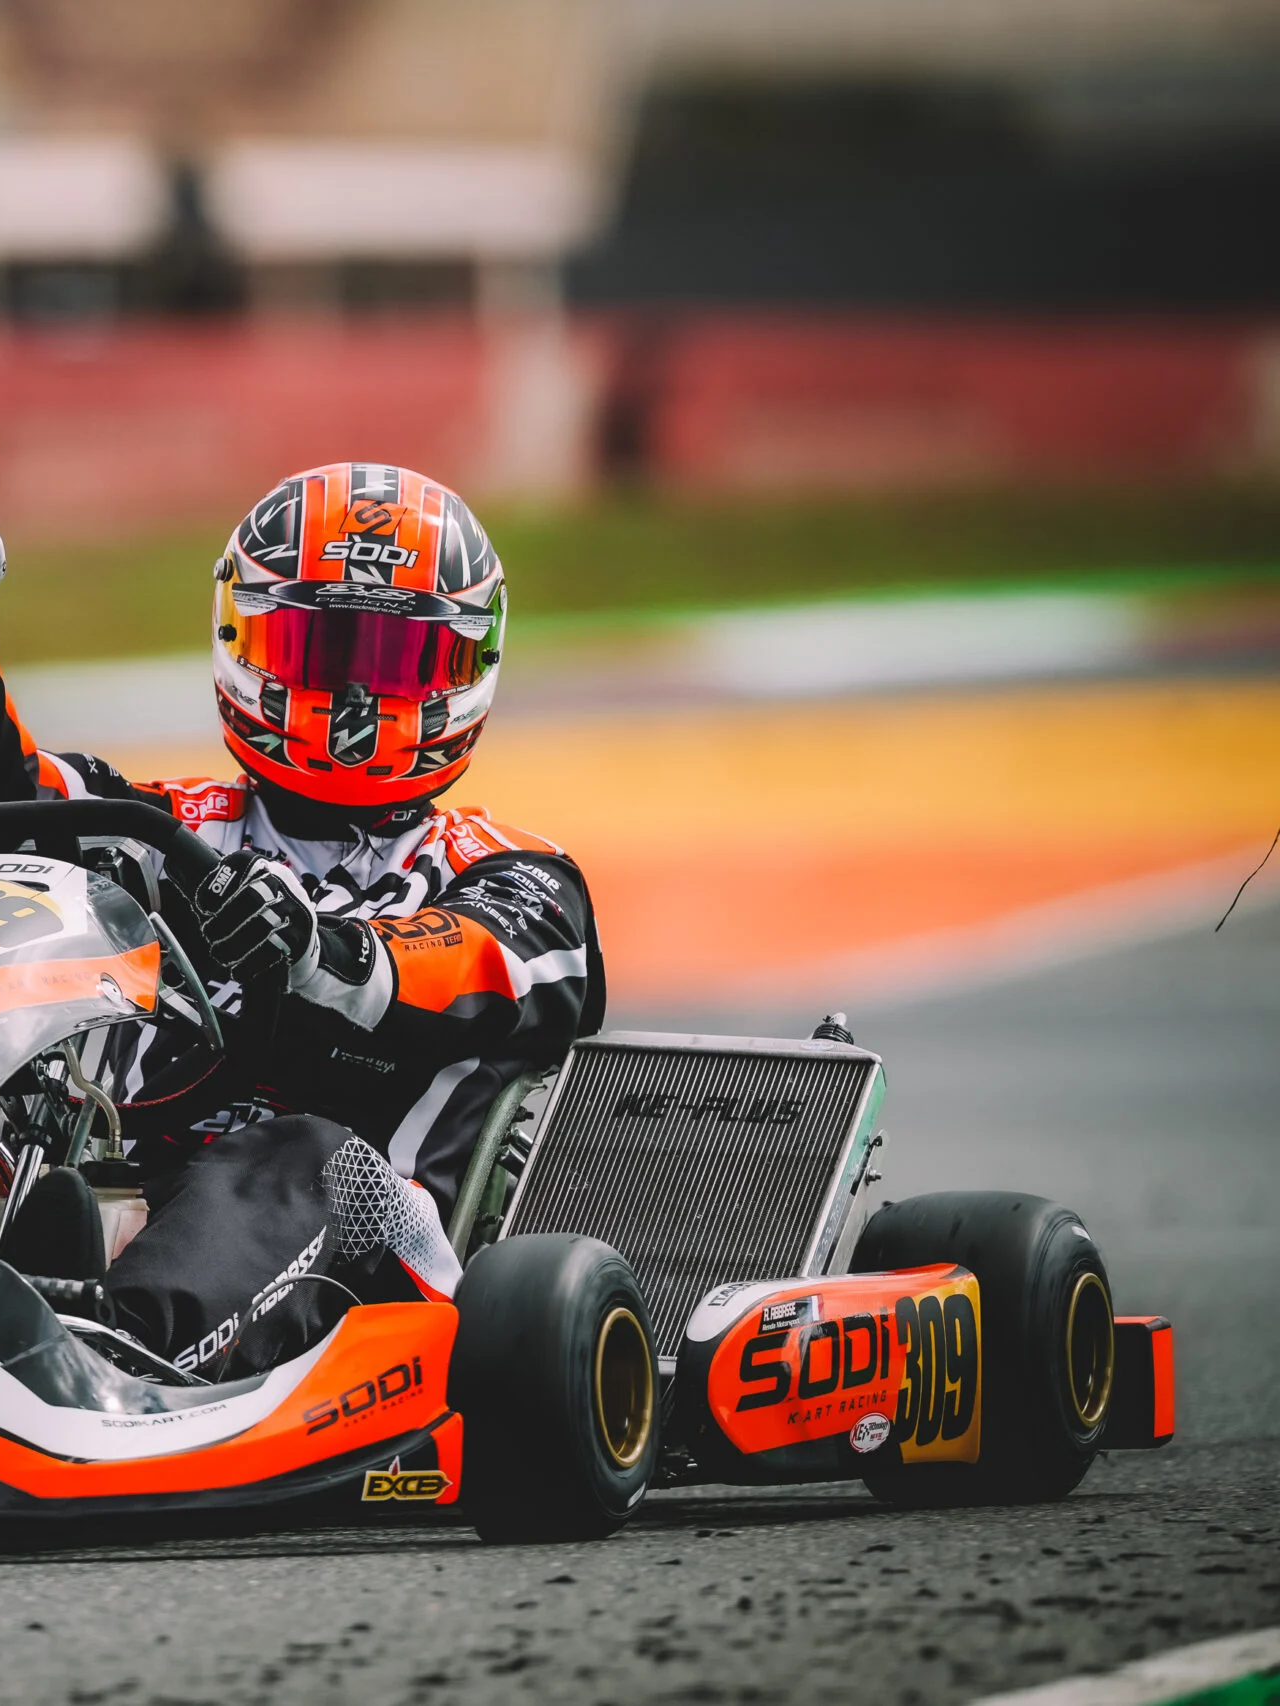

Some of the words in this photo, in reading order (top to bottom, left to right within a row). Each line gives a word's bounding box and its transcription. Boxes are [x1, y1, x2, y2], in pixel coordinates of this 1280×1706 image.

[181, 796, 228, 819] OMP
[450, 823, 489, 858] OMP
[212, 865, 232, 894] OMP
[404, 939, 442, 951] RACING
[893, 1293, 977, 1447] 309
[787, 1405, 832, 1425] KART
[839, 1390, 887, 1413] RACING
